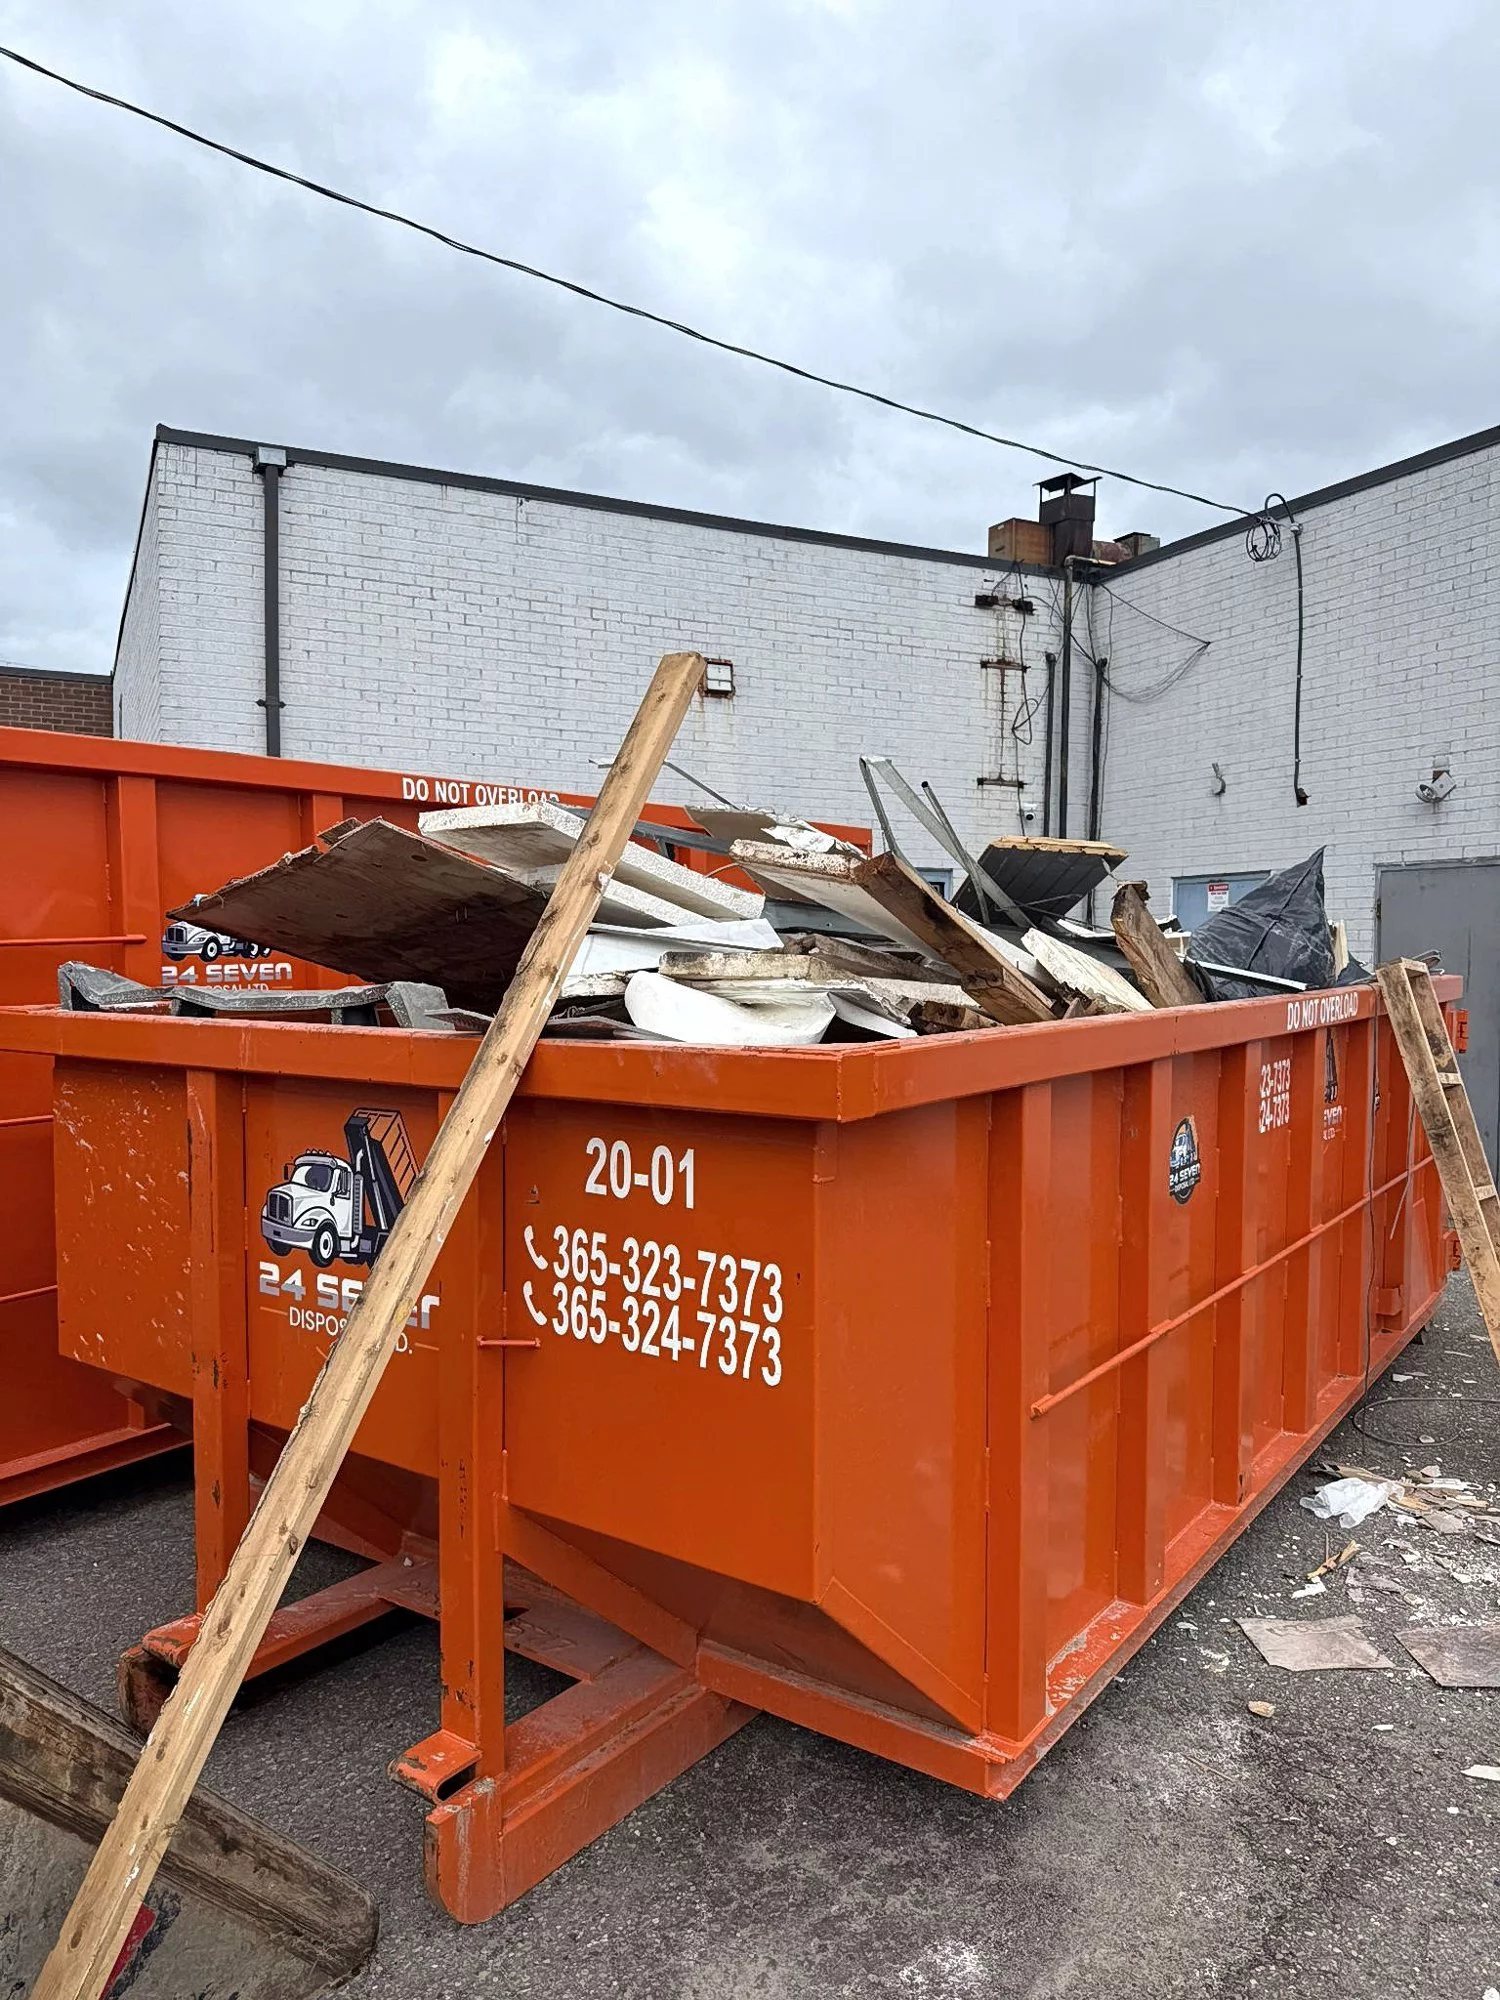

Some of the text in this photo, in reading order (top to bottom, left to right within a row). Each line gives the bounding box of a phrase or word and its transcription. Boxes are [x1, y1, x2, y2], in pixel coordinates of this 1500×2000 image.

[402, 777, 429, 801] DO
[434, 781, 471, 805] NOT
[161, 962, 292, 984] 24 SEVEN
[1287, 991, 1359, 1031] DO NOT OVERLOAD
[1260, 1059, 1291, 1099] 23-7373
[1259, 1091, 1290, 1134] 24-7373
[585, 1137, 695, 1209] 20-01
[259, 1261, 306, 1302] 24
[552, 1224, 784, 1324] 365-323-7373
[551, 1281, 783, 1387] 365-324-7373
